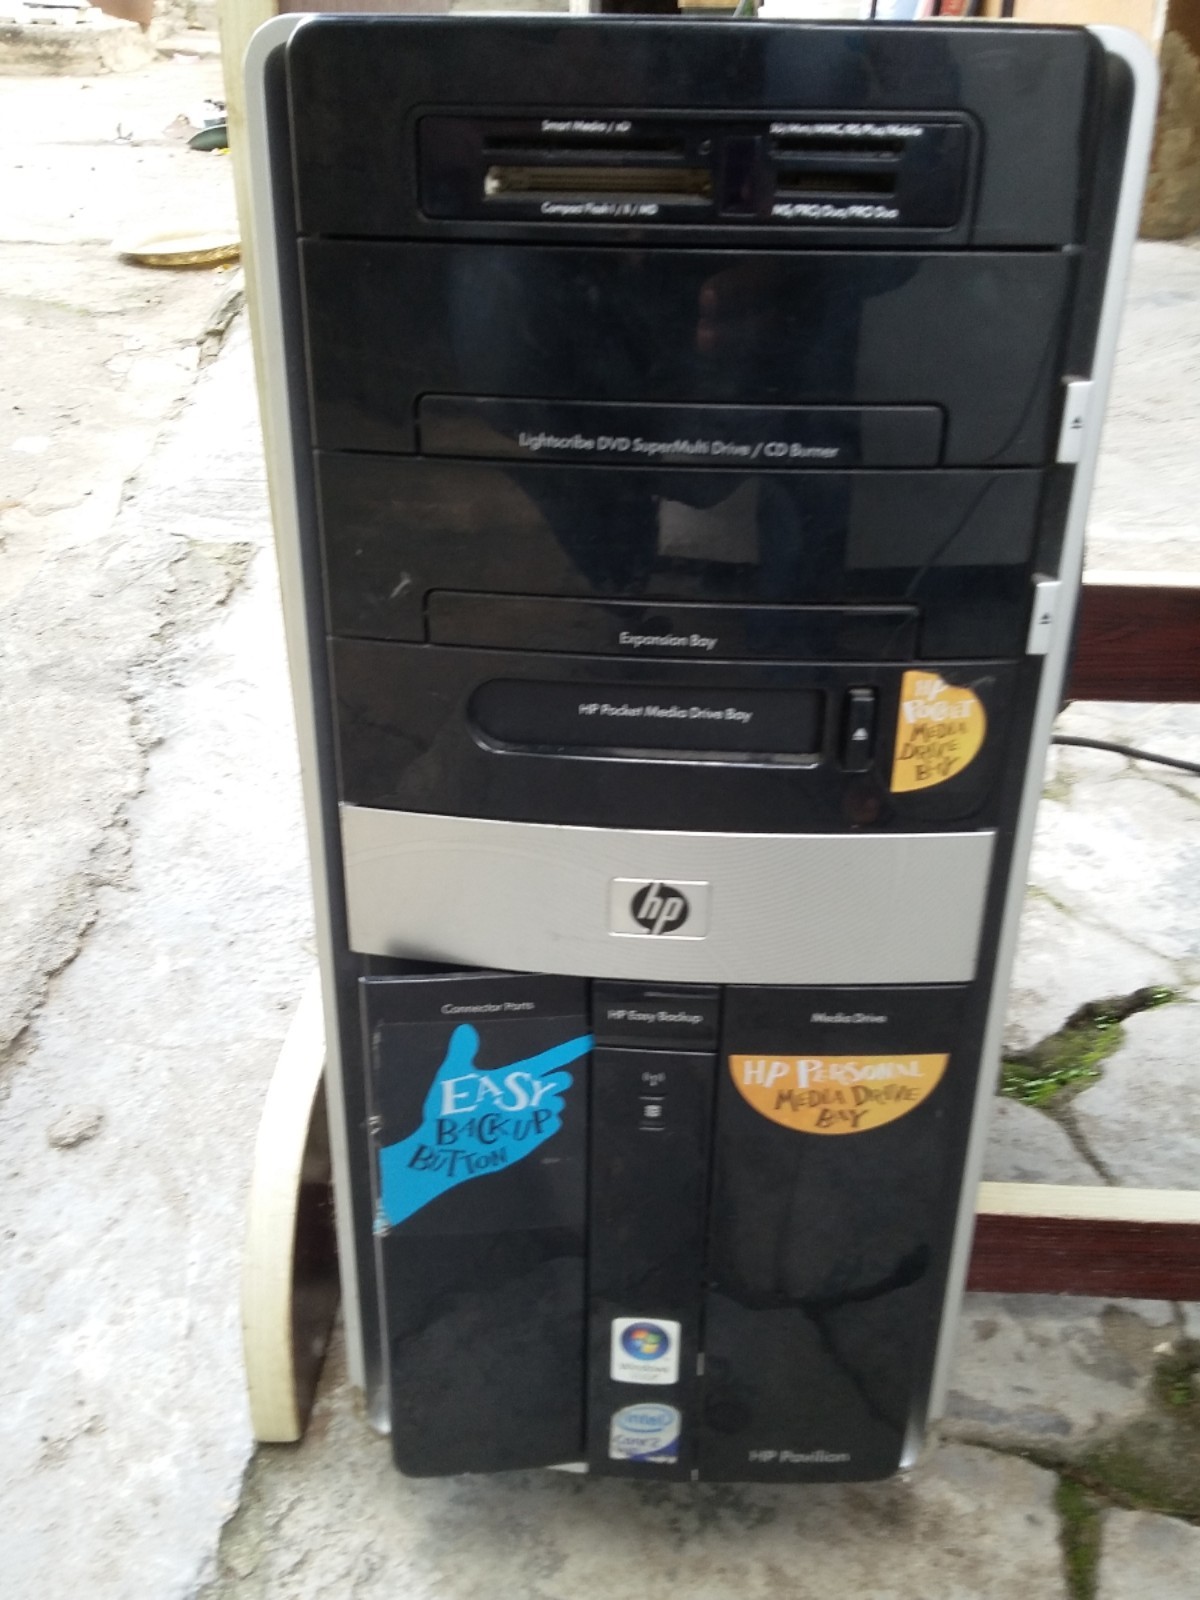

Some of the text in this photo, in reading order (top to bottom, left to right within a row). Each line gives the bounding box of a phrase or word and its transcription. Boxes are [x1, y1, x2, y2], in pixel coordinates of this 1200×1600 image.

[518, 432, 595, 451] Lightscribe
[596, 435, 631, 451] DVD
[632, 437, 710, 456] SuperMulti
[710, 440, 751, 455] Drive
[763, 441, 789, 457] CD
[789, 442, 840, 458] Burner
[618, 631, 718, 650] Expansion Bay
[578, 703, 753, 723] HP Pocket Media Drive Bay
[910, 722, 968, 742] MEDIA
[637, 882, 684, 936] hp
[440, 1002, 535, 1014] Connector Ports
[607, 1010, 704, 1025] HP Easy Backup
[810, 1012, 888, 1024] Media Drive
[742, 1059, 926, 1089] HP PERSONAL
[439, 1071, 558, 1116] EASY
[774, 1084, 922, 1112] MEDIA DRIVE
[435, 1108, 553, 1146] BACKUP
[814, 1107, 869, 1128] BAY
[407, 1143, 509, 1178] BUTTON
[748, 1449, 851, 1463] HP Pavilion
